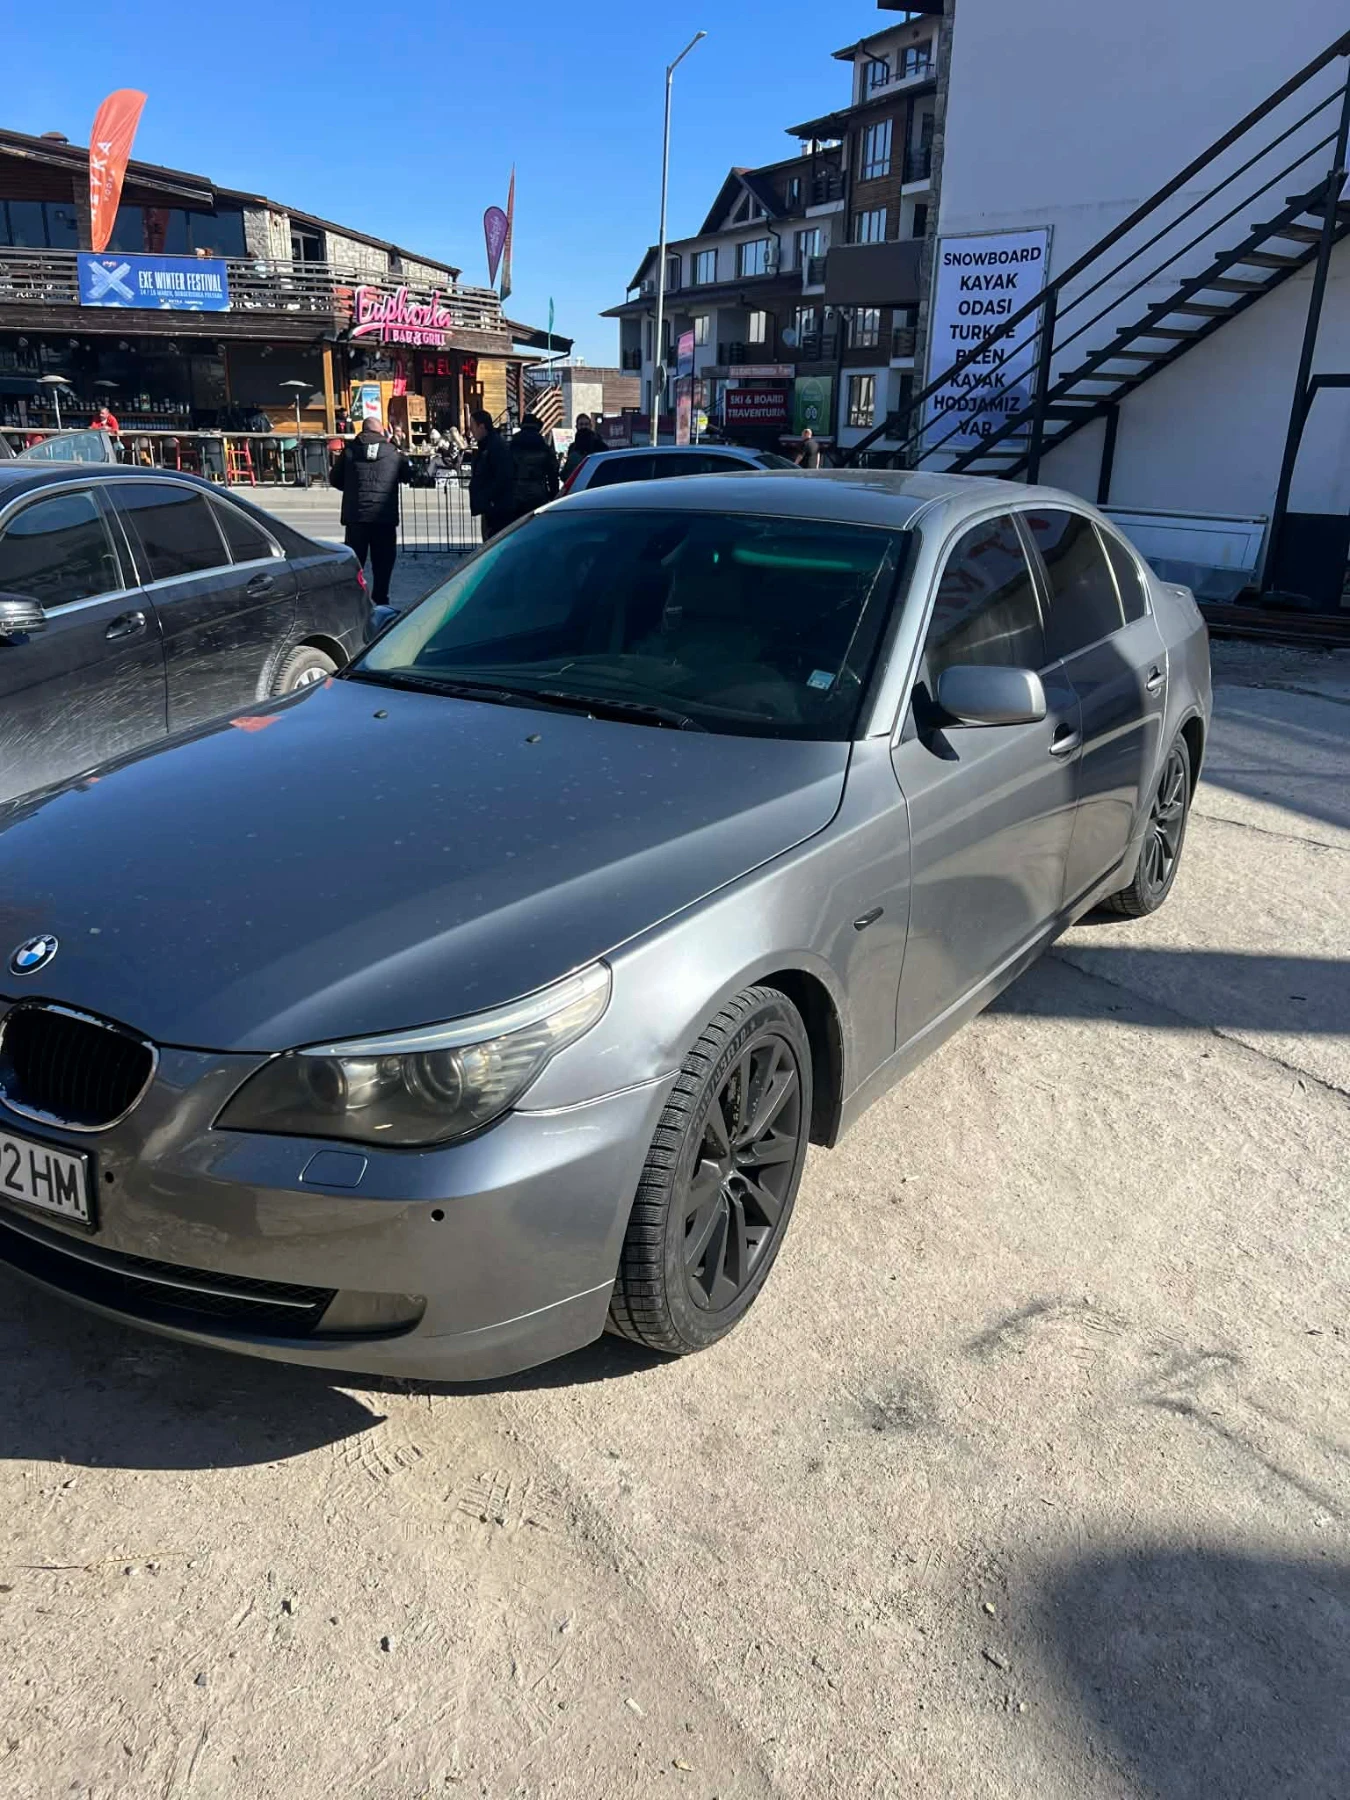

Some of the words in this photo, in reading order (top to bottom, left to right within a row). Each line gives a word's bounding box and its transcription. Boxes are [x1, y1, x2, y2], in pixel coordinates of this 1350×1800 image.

[943, 247, 1042, 267] SNOWBOARD
[138, 270, 154, 289] EXE
[154, 271, 186, 291] WINTER
[186, 273, 223, 293] FESTIVAL
[959, 273, 1019, 291] KAYAK
[354, 284, 452, 342] Euphoria
[958, 298, 1013, 316] ODASI
[392, 329, 412, 343] BAR
[422, 332, 446, 347] GRILL
[949, 324, 1016, 340] TURKE
[956, 348, 1005, 365] BLEN
[950, 373, 1007, 389] KAYAK
[730, 395, 744, 405] SKI
[753, 394, 784, 405] BOARD
[933, 395, 1021, 413] HODJAMIZ
[958, 420, 993, 437] VAR
[0, 1142, 24, 1192] 2
[29, 1150, 80, 1211] HM
